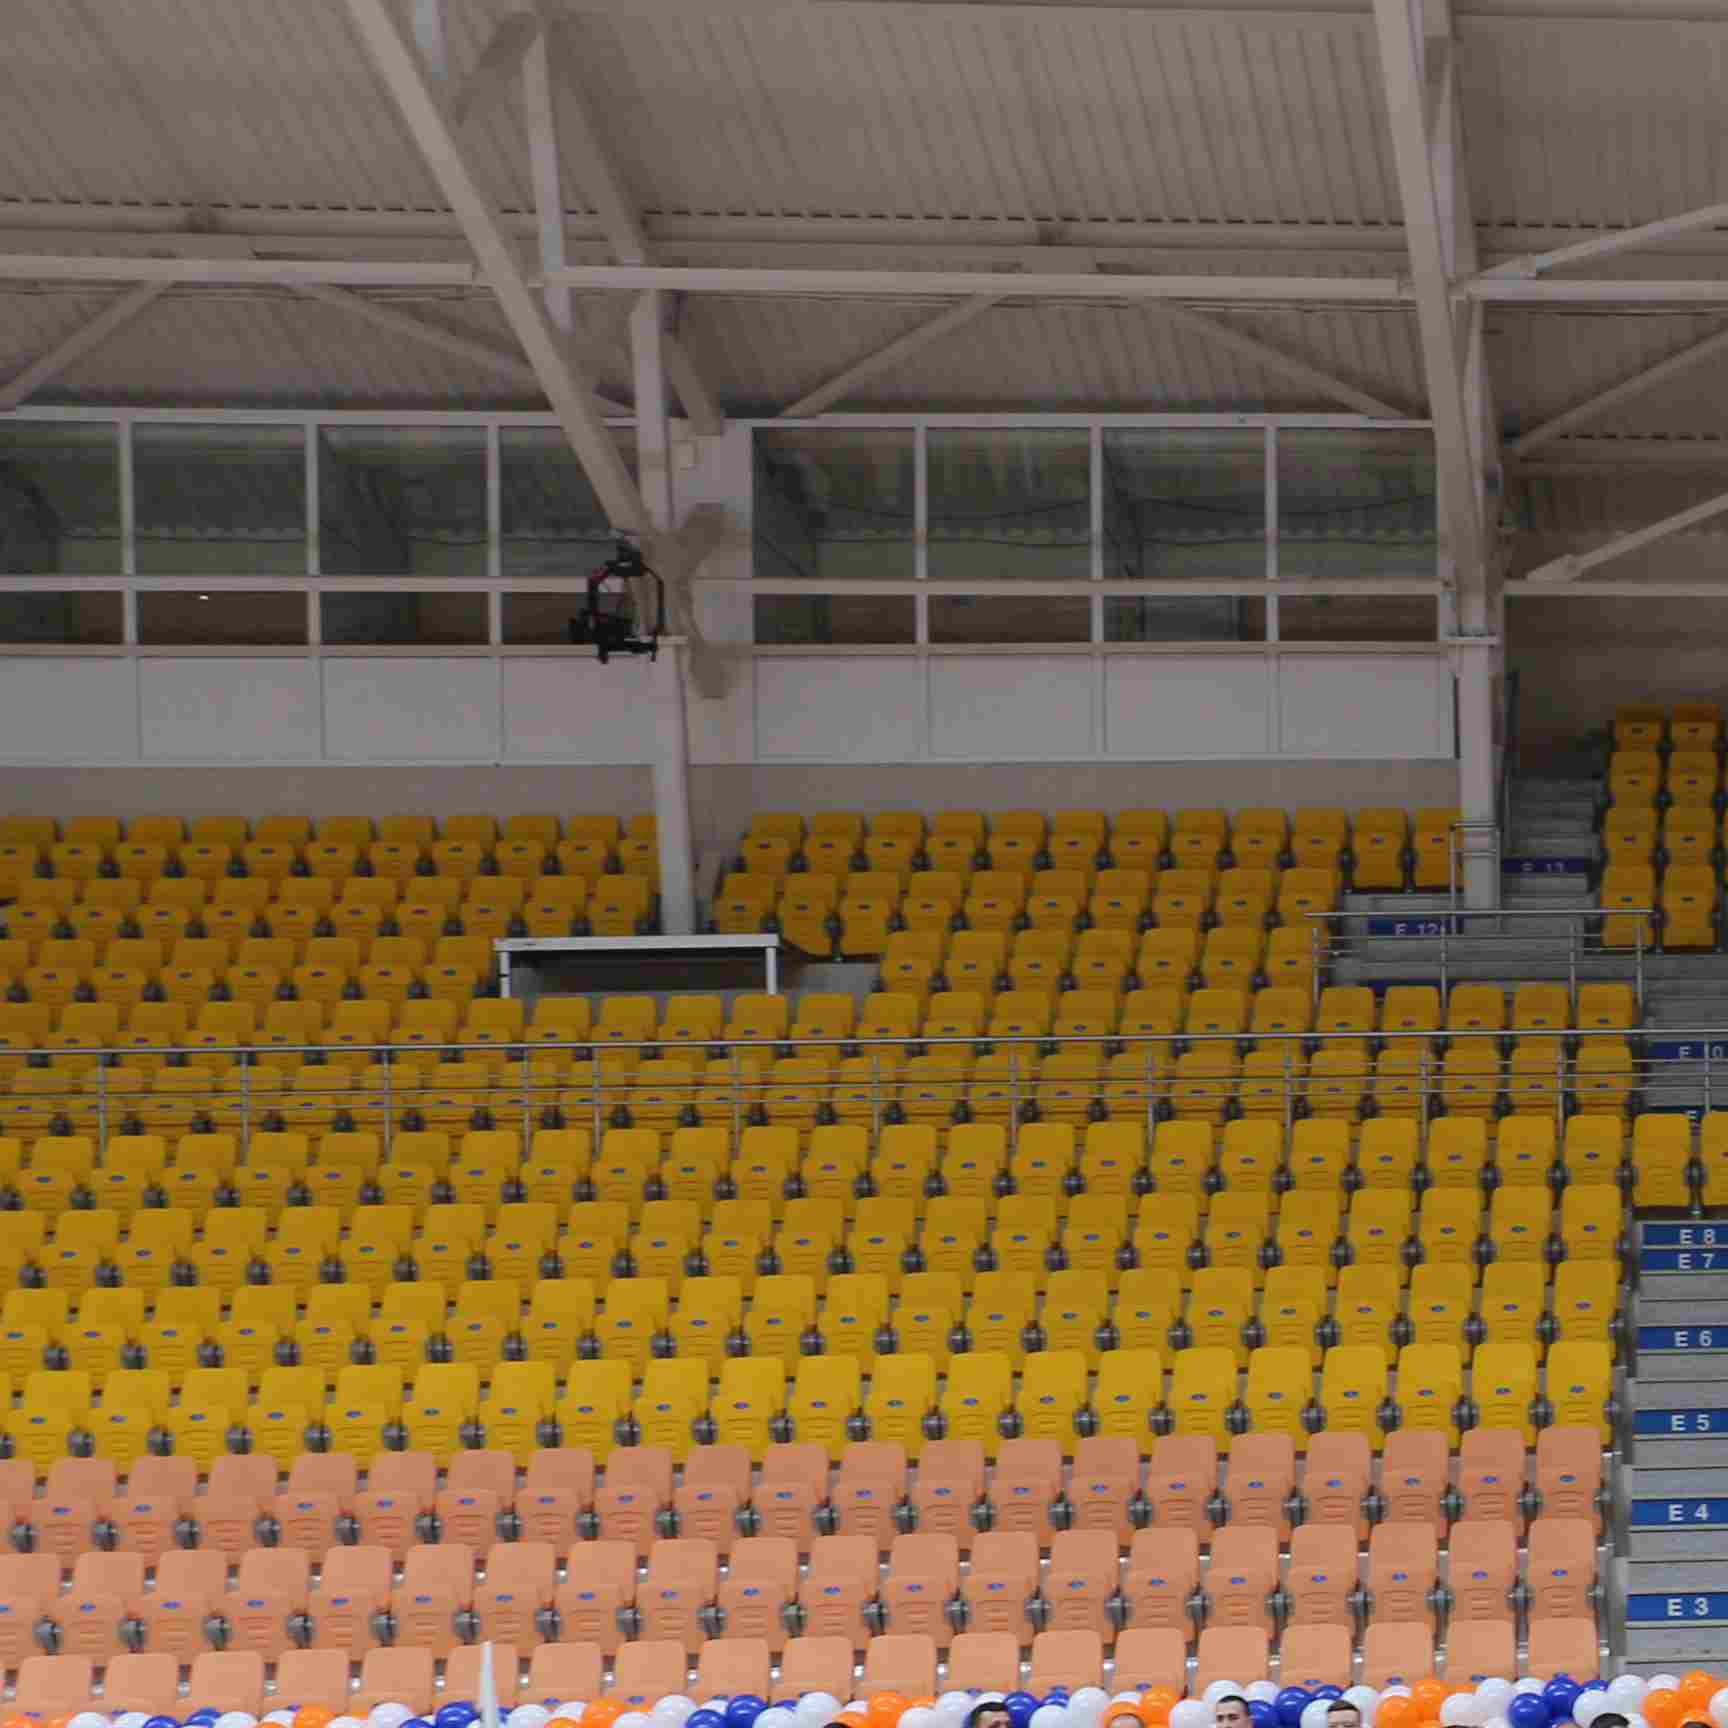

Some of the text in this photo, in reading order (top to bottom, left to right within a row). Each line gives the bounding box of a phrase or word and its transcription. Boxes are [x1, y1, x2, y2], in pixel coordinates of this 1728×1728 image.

[1680, 1228, 1715, 1246] E 8
[1679, 1253, 1715, 1269] E 7
[1674, 1330, 1711, 1347] E 6
[1671, 1414, 1710, 1431] E 5
[1668, 1503, 1709, 1521] E 4
[1667, 1597, 1709, 1617] E 3
